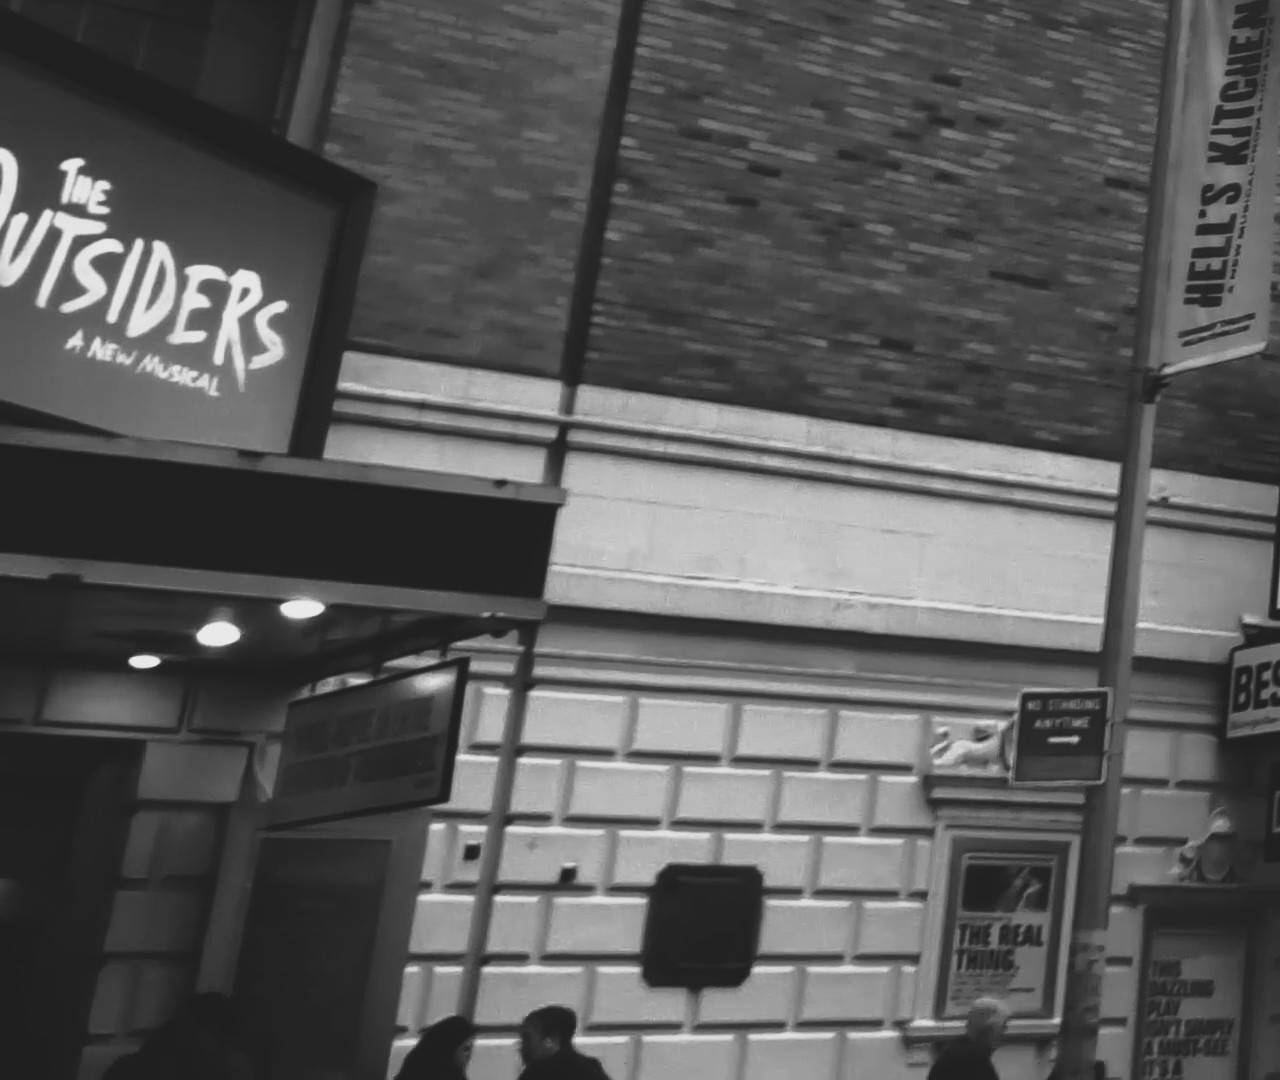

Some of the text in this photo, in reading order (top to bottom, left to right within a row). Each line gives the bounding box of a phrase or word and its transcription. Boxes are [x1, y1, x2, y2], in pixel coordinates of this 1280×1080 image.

[59, 158, 112, 214] THE
[1183, 182, 1243, 308] HELL'S
[64, 329, 220, 397] A NEW MUSICAL
[959, 924, 1043, 947] THE REAL
